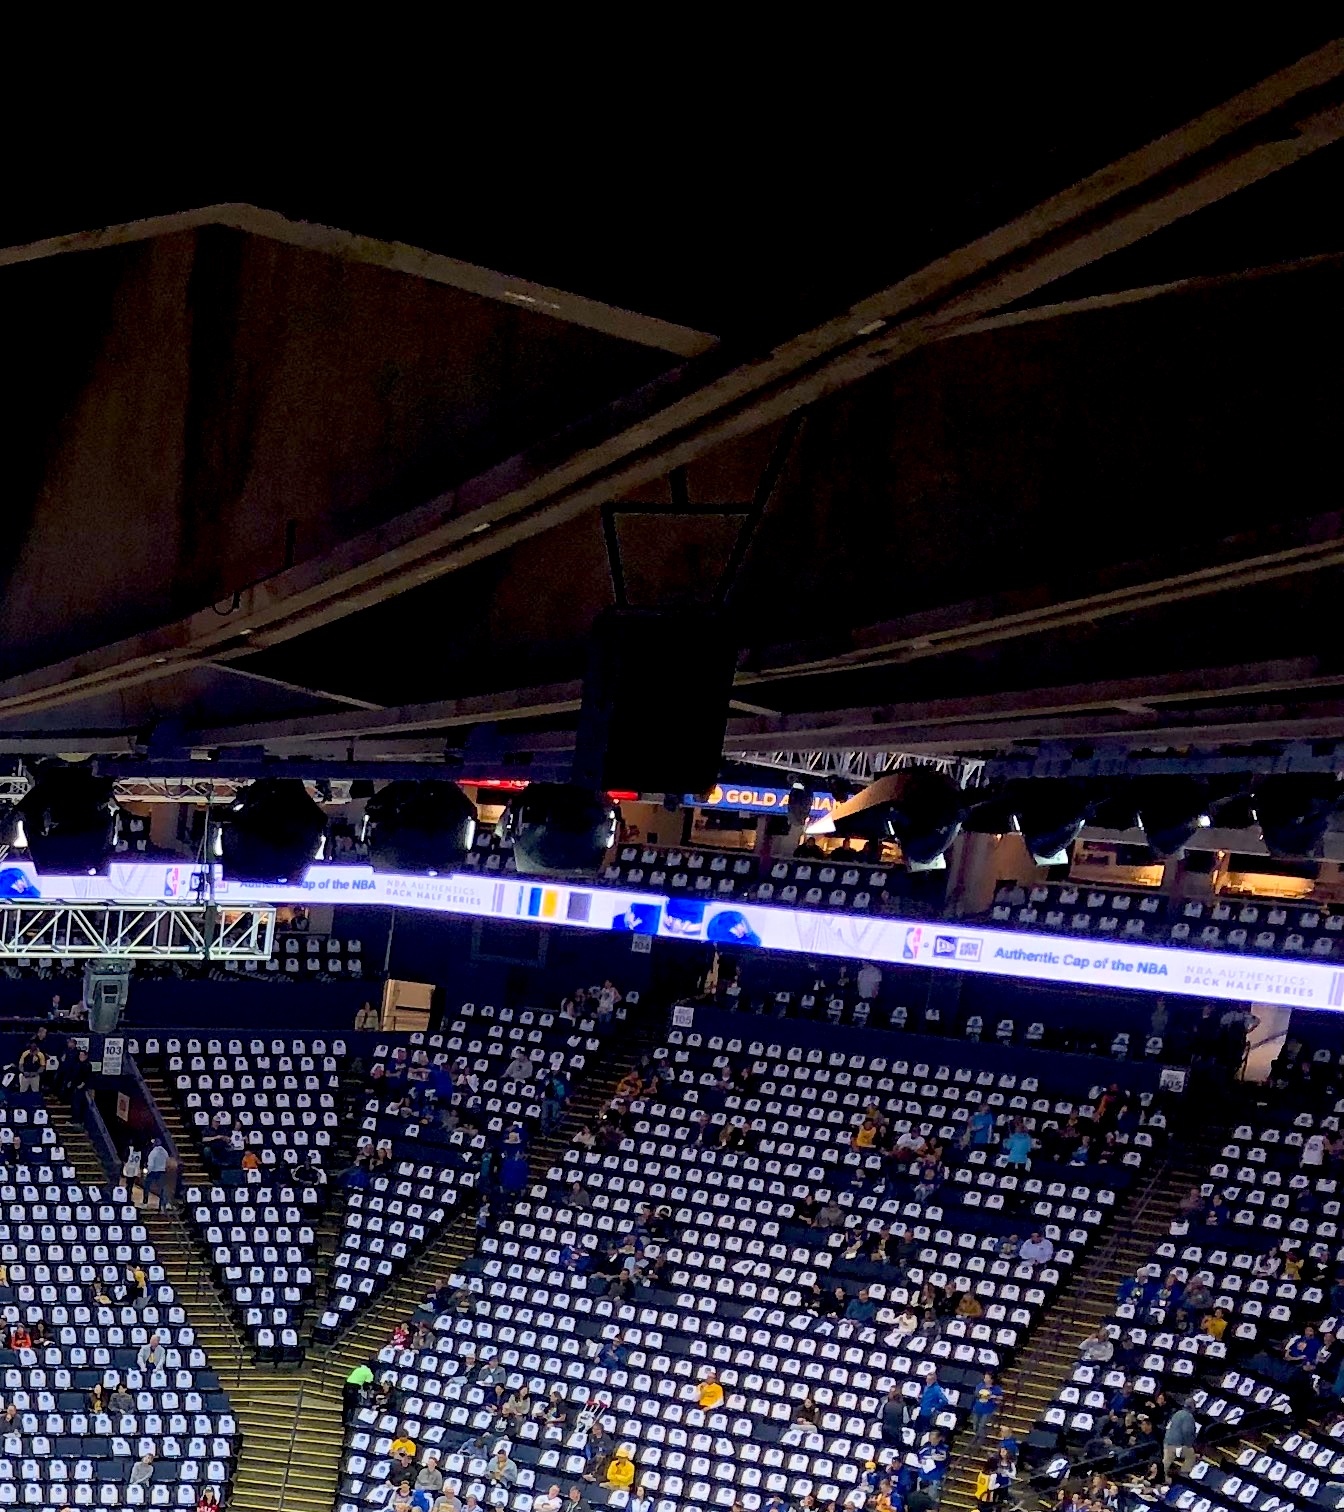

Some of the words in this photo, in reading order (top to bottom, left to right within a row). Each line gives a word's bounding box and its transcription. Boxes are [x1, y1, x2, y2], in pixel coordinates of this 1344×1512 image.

[726, 789, 778, 807] GOLD
[317, 878, 330, 890] of
[331, 878, 350, 890] the
[352, 879, 376, 891] NBA
[446, 895, 482, 906] SERIES
[994, 945, 1059, 965] Authentic
[1063, 953, 1090, 971] Cap
[1092, 956, 1109, 970] of
[1111, 958, 1134, 974] the
[1136, 961, 1168, 977] NBA
[1266, 985, 1314, 998] SERIES
[675, 1015, 692, 1025] 105
[106, 1046, 122, 1056] 103
